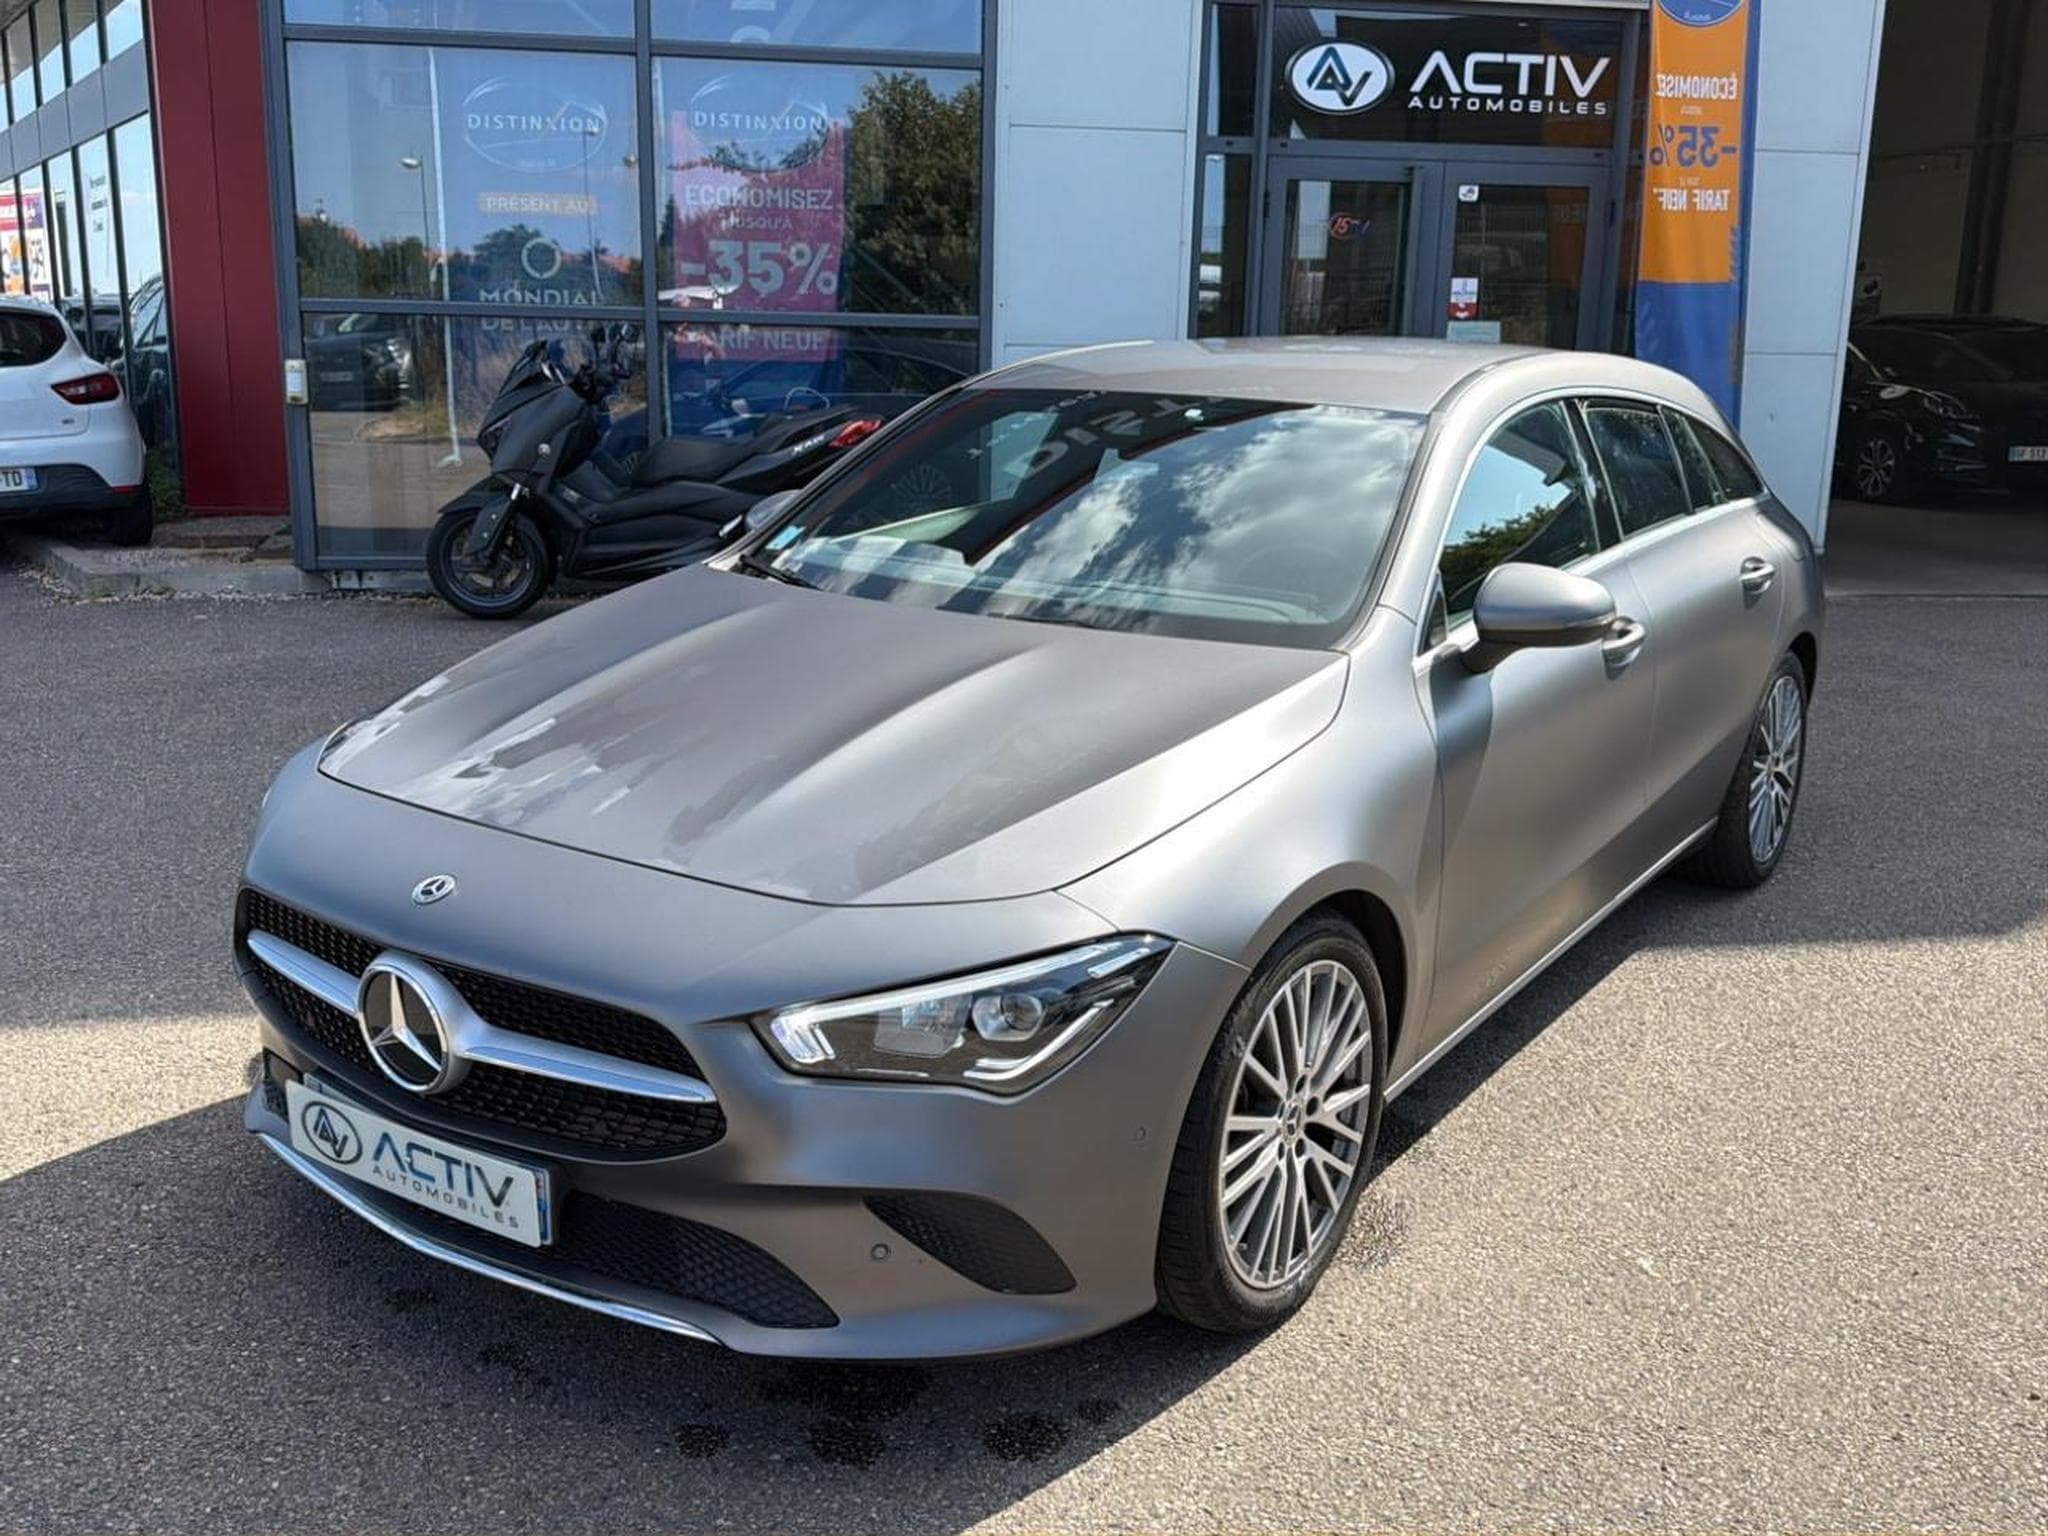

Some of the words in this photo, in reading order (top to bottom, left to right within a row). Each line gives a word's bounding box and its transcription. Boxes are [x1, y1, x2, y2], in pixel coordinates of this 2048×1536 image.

[1409, 50, 1611, 98] ACTIV
[467, 114, 600, 132] DISTINXION
[694, 111, 823, 131] DISTINXION
[1407, 96, 1607, 115] AUTOMOBILES
[680, 239, 838, 294] -35%
[373, 1131, 514, 1207] ACTIV
[372, 1164, 520, 1229] AUTOMOBILES
